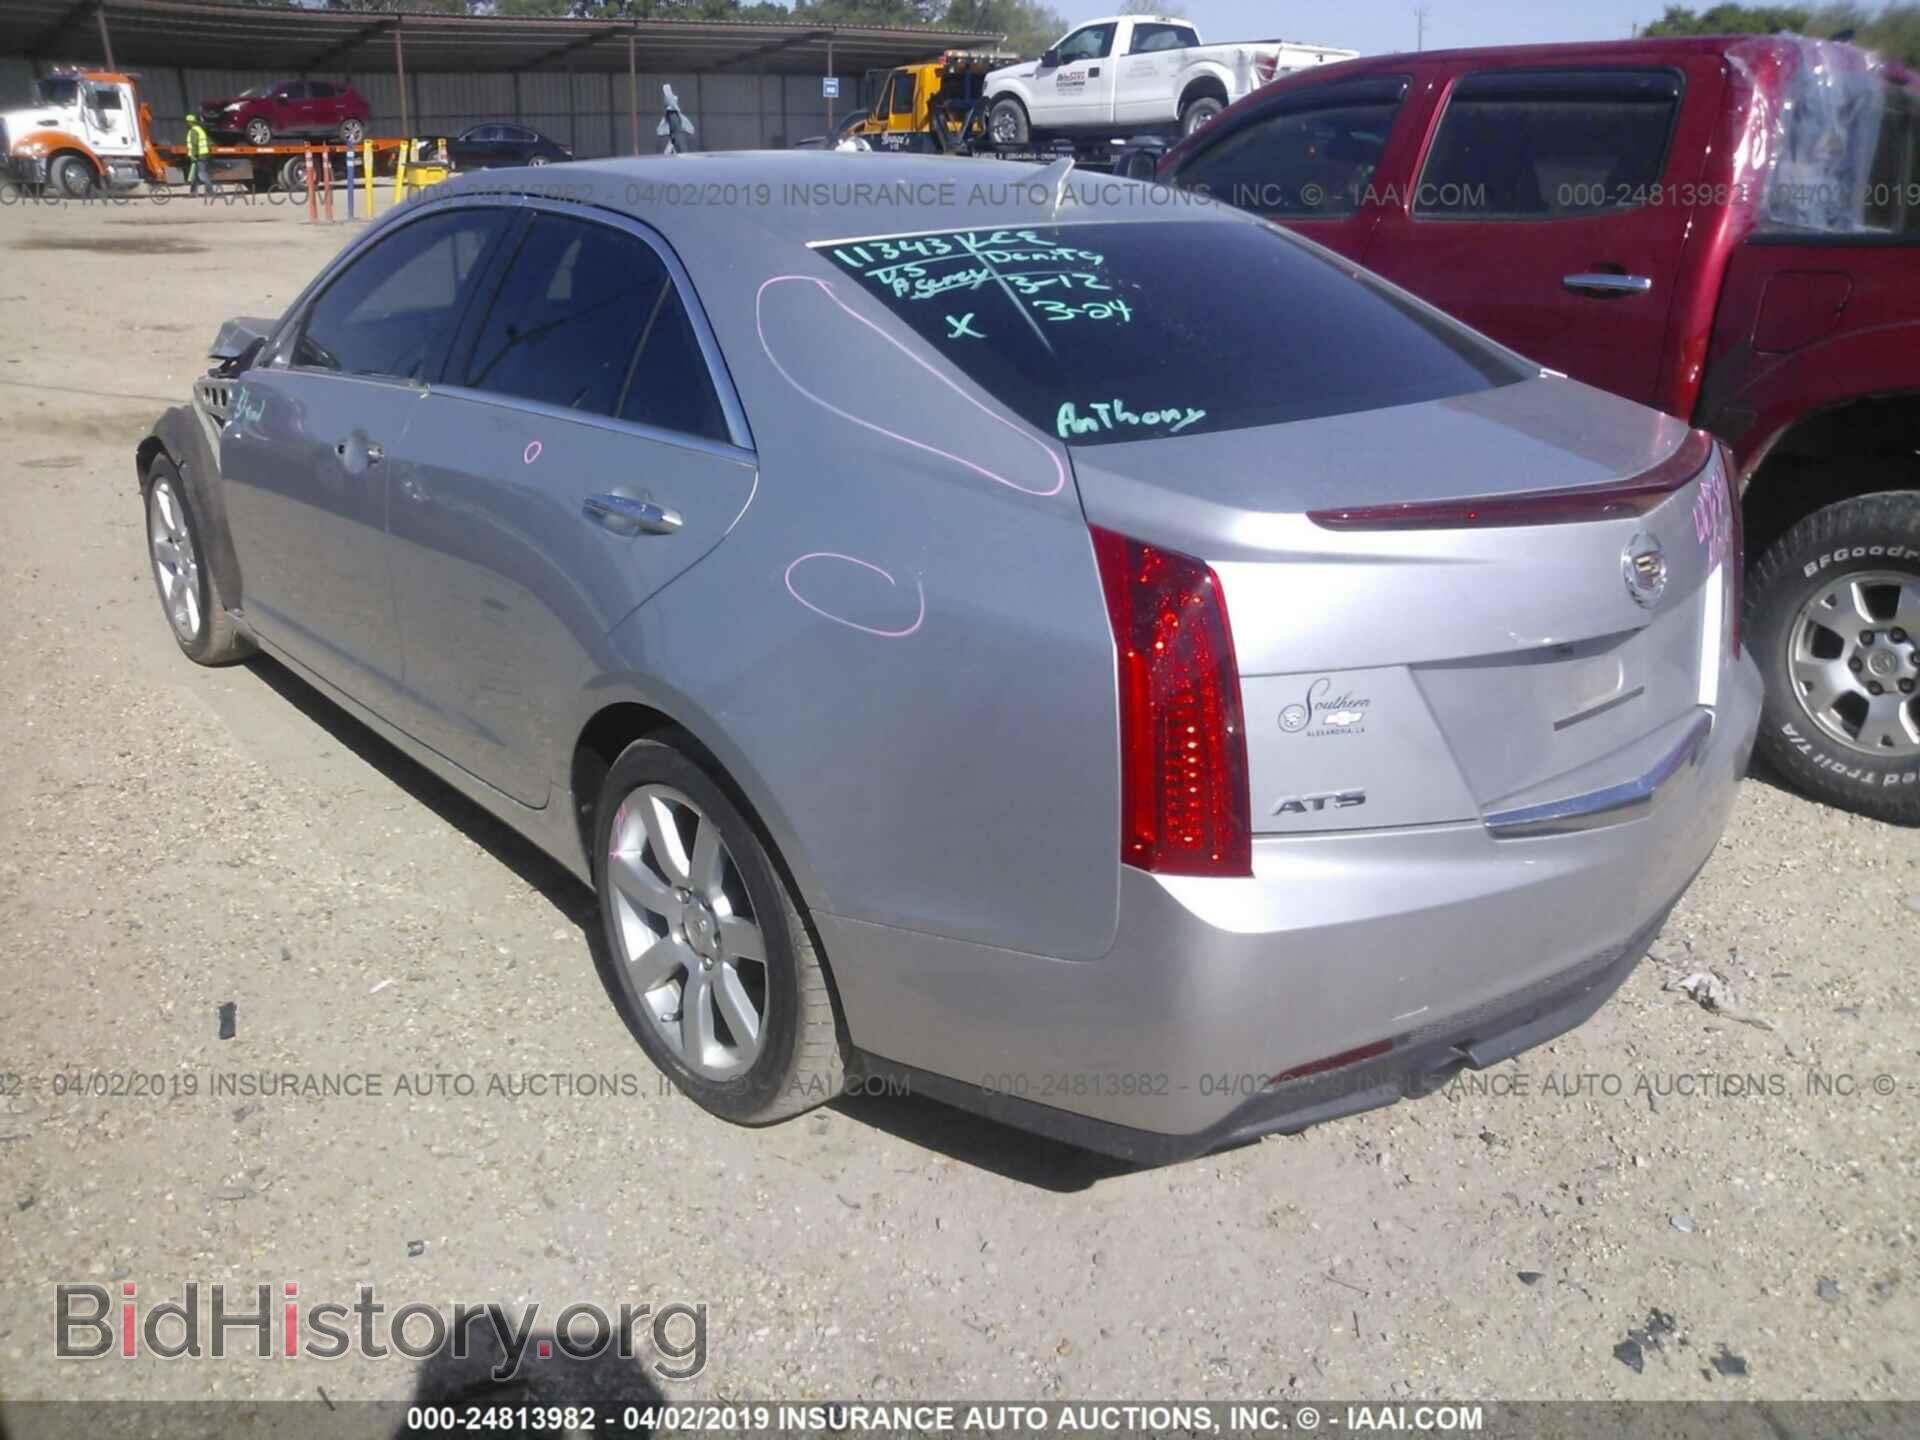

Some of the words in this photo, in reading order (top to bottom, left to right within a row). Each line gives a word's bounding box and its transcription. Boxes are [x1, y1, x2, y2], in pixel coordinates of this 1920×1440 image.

[1032, 299, 1133, 323] 3-24
[1278, 677, 1371, 734] Southern
[1272, 788, 1367, 816] ATS
